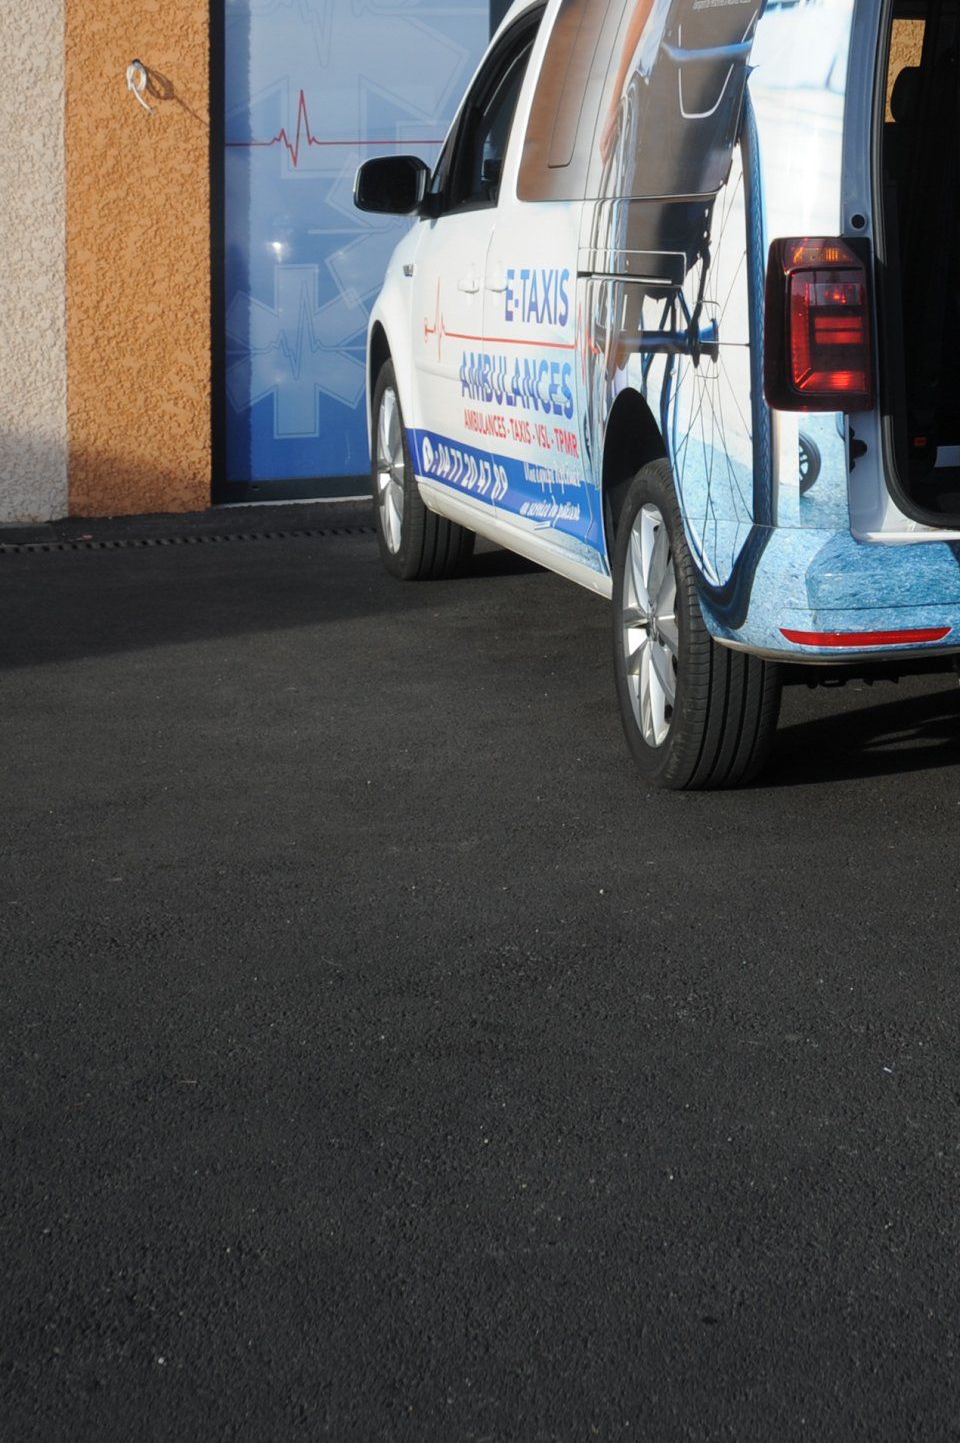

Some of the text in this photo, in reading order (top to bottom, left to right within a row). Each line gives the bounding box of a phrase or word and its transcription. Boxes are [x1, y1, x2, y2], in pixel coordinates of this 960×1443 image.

[504, 268, 569, 327] E-TAXIS
[459, 350, 574, 420] AMBULANCES
[464, 409, 507, 439] AMBULANCES
[509, 418, 531, 444] TAXIS
[534, 423, 551, 449] VSL
[553, 427, 579, 458] TPMR
[436, 443, 450, 478] 04
[448, 447, 463, 483] 77
[461, 452, 478, 490] 20
[477, 459, 491, 495] 47
